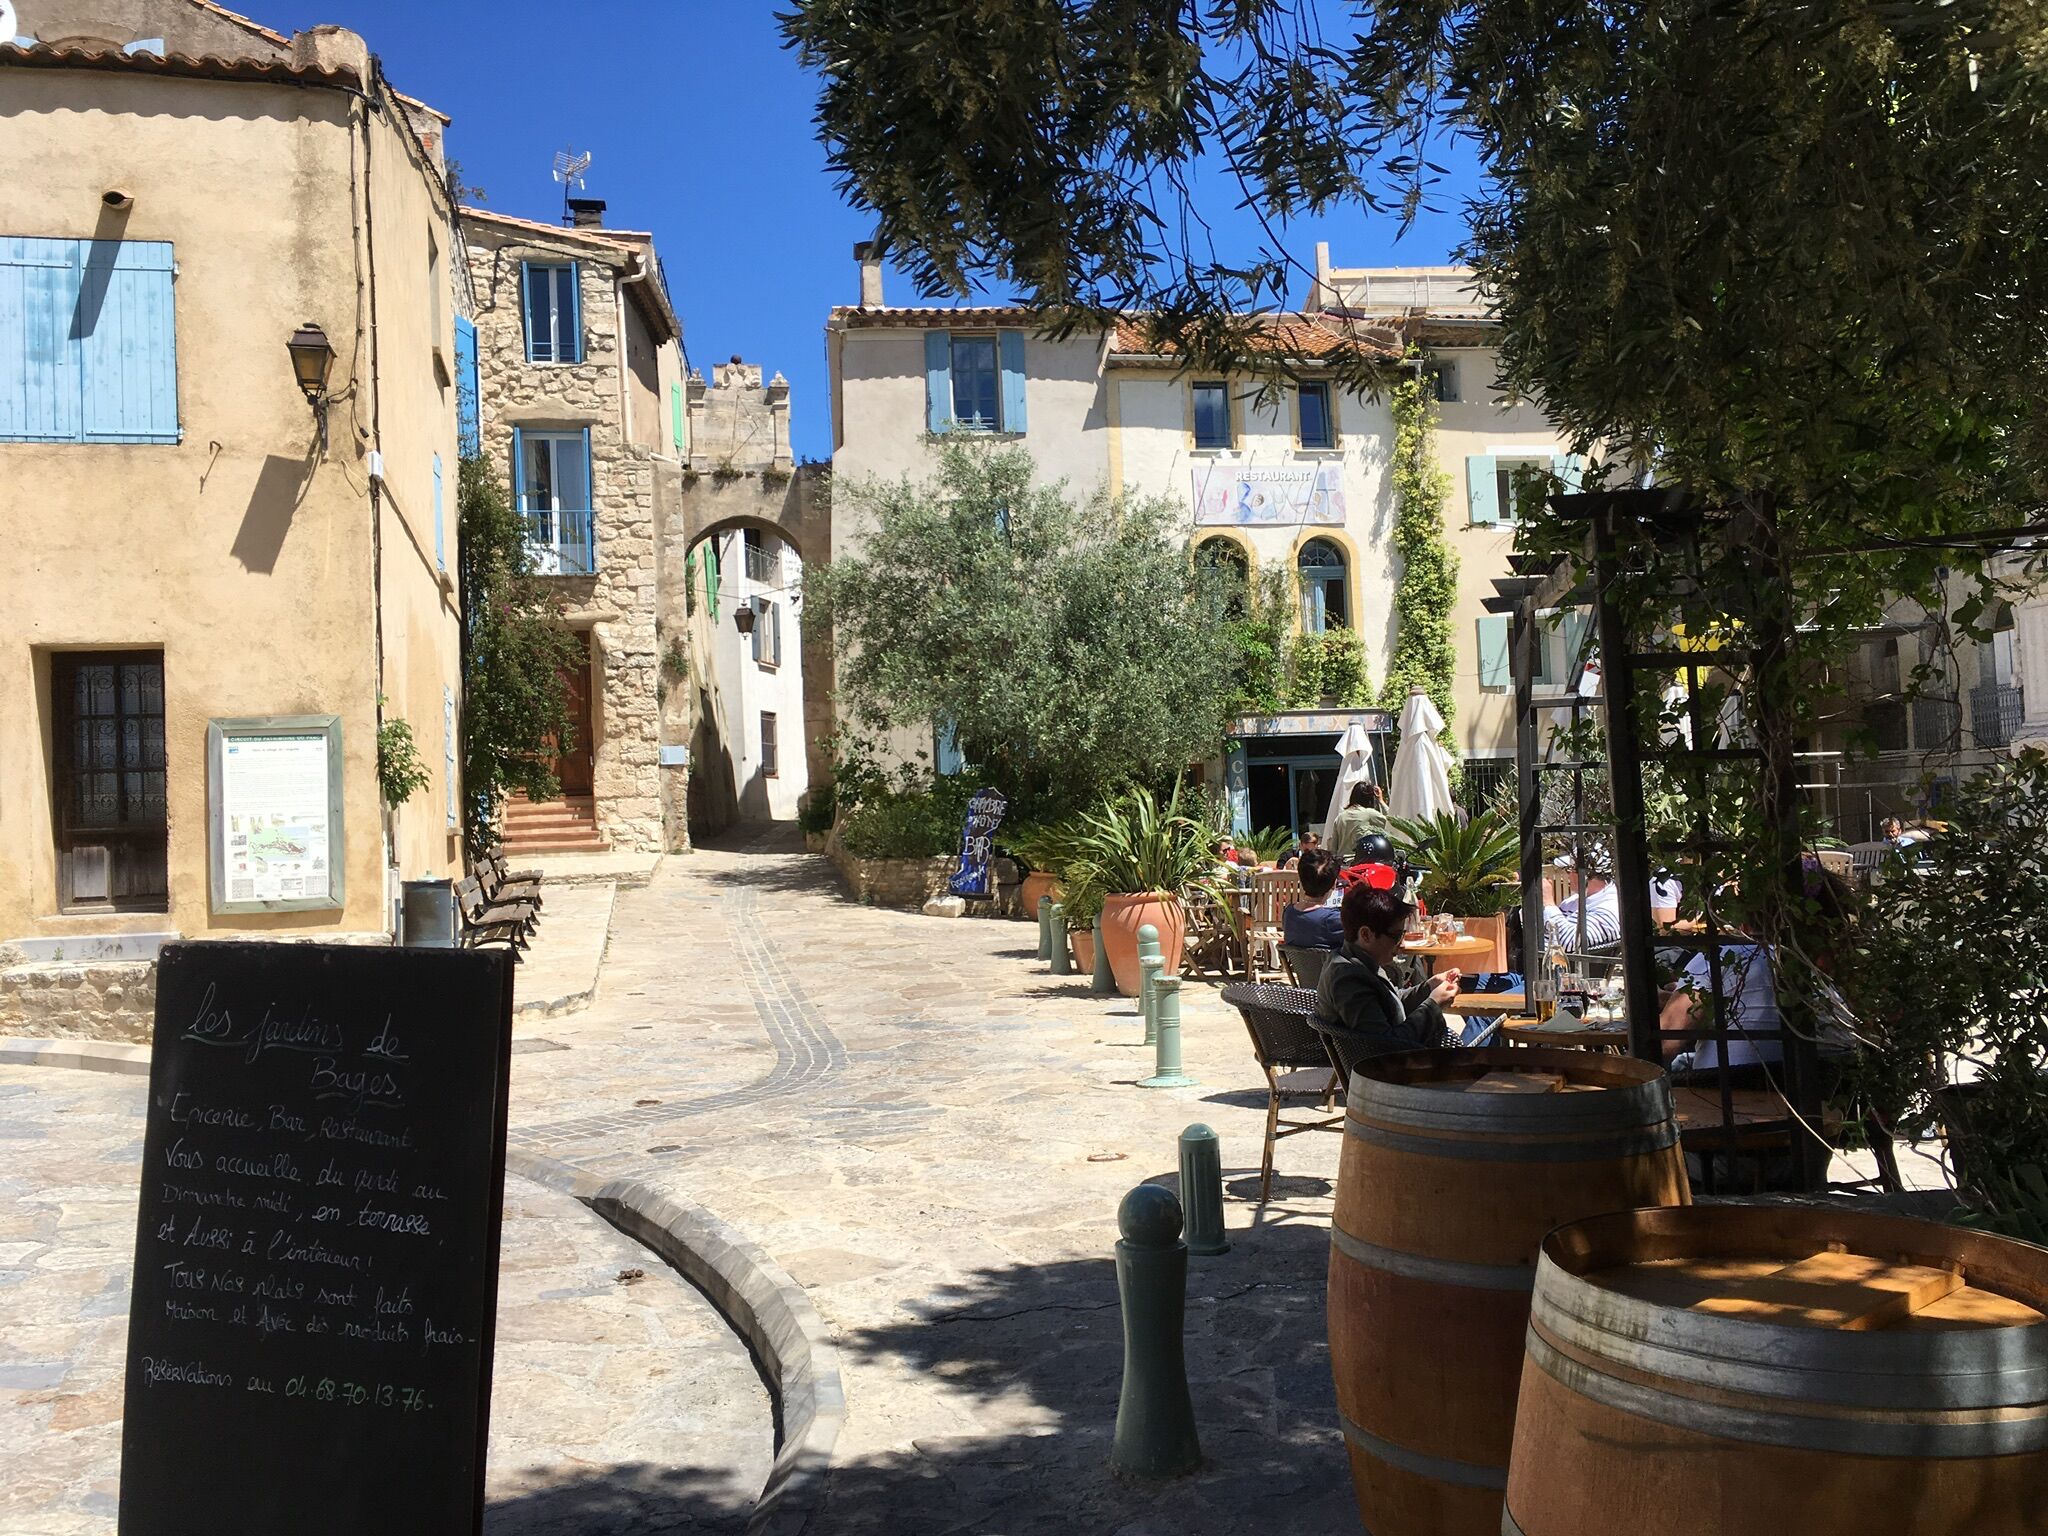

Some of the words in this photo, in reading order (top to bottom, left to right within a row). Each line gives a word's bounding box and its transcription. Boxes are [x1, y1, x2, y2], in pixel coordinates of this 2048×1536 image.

[1235, 471, 1311, 483] RESTAURANT
[366, 1012, 410, 1059] de
[165, 1137, 204, 1169] Vous
[216, 1153, 301, 1182] accueille
[315, 1157, 345, 1186] du
[411, 1184, 449, 1200] au
[161, 1183, 246, 1208] Dimanche
[311, 1205, 341, 1221] en
[157, 1213, 176, 1243] et
[240, 1230, 257, 1255] à
[163, 1261, 205, 1291] Tous
[251, 1273, 305, 1308] plats
[314, 1283, 358, 1306] sont
[374, 1286, 414, 1323] faits
[165, 1299, 219, 1321] Maison
[230, 1304, 247, 1325] et
[337, 1320, 409, 1343] produits
[248, 1376, 276, 1394] au
